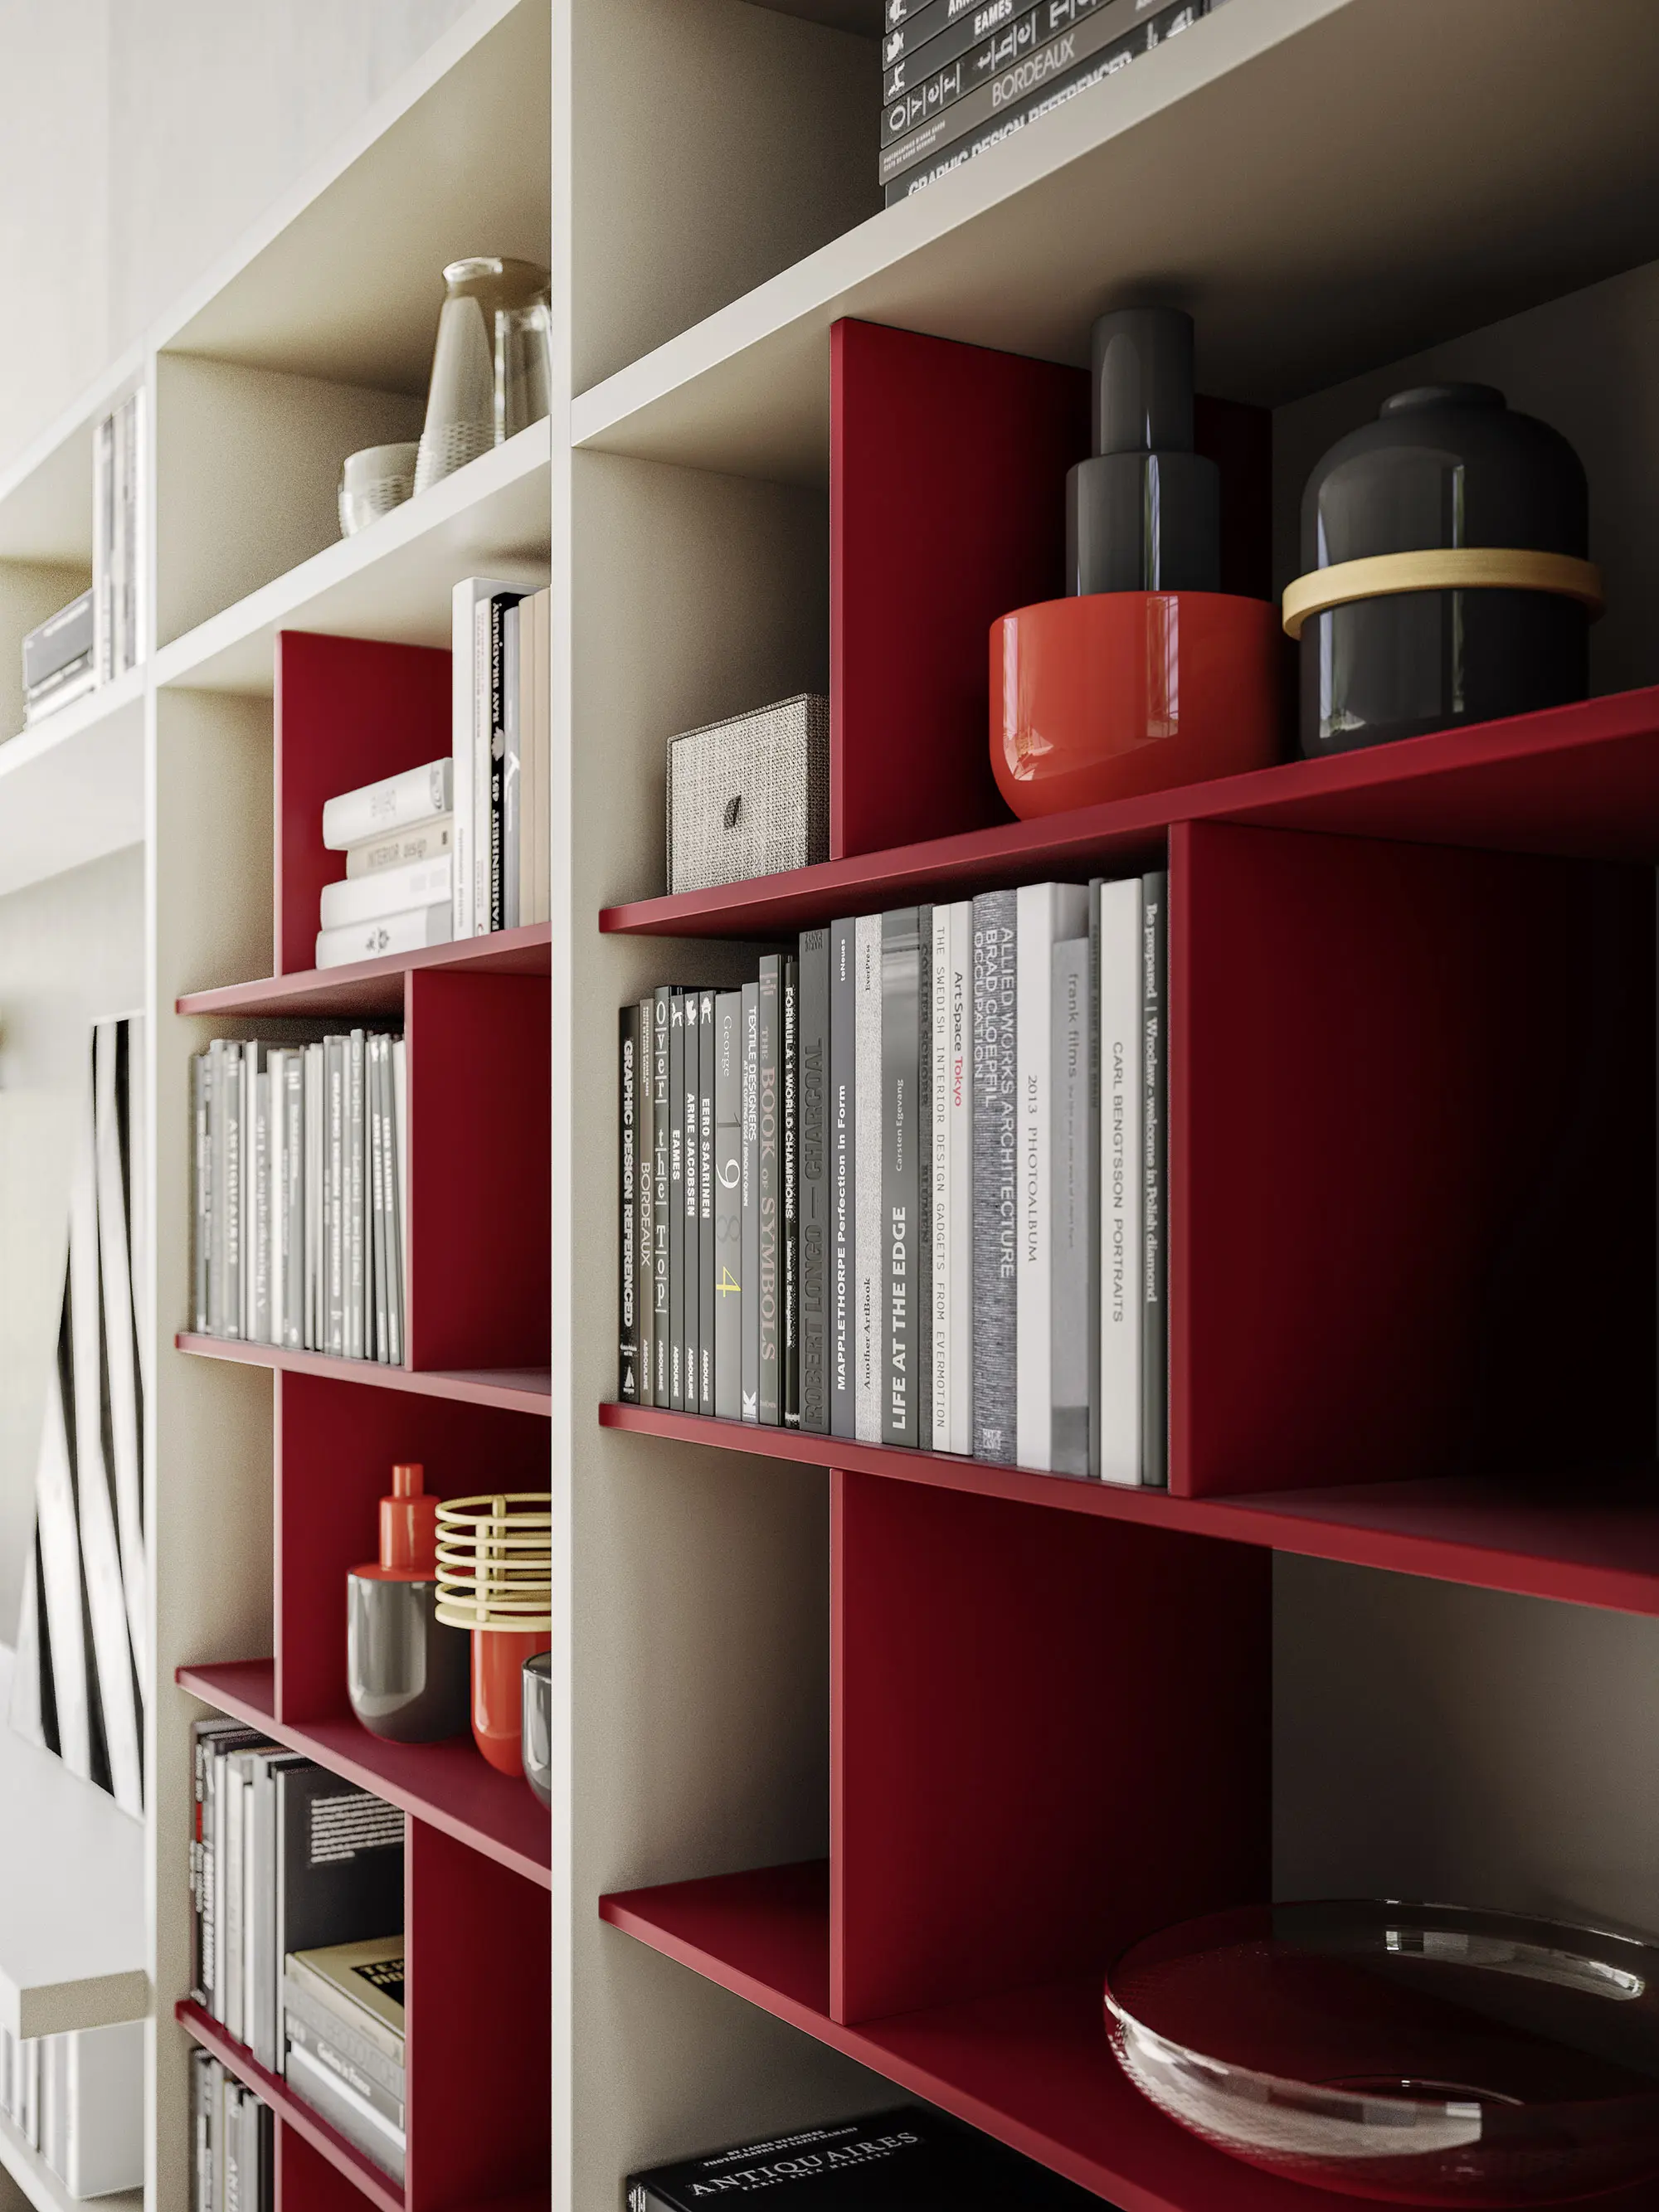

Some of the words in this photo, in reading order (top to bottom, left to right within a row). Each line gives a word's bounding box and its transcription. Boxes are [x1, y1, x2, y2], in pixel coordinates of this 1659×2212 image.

[974, 0, 1013, 36] EAMES
[992, 34, 1074, 107] BORDEAUX
[491, 773, 499, 802] 451
[937, 926, 945, 955] THE
[1146, 903, 1158, 925] Be
[954, 971, 963, 998] Art
[985, 929, 997, 991] BRAD
[1000, 928, 1014, 1006] ALLIED
[1144, 926, 1158, 999] prepared
[786, 987, 794, 1059] FORMULA
[937, 967, 945, 1033] SWEDISH
[954, 1000, 963, 1052] Space
[975, 931, 984, 1079] OCCUPATION
[1068, 974, 1079, 1023] frank
[722, 1015, 732, 1077] George
[748, 1006, 757, 1061] TEXTILE
[985, 999, 997, 1108] CLOEPFIL
[1000, 1013, 1014, 1094] WORKS
[1068, 1030, 1079, 1078] films
[1113, 1042, 1123, 1090] CARL
[624, 1040, 634, 1125] GRAPHIC
[687, 1093, 695, 1134] ARNE
[748, 1063, 757, 1141] DESIGNERS
[761, 1067, 775, 1159] BOOK
[786, 1074, 794, 1128] WORLD
[805, 1038, 823, 1180] CHARCOAL
[838, 1086, 846, 1129] Form
[896, 1079, 904, 1125] Egevang
[937, 1047, 945, 1123] INTERIOR
[954, 1056, 963, 1107] Tokyo
[1028, 1074, 1038, 1115] 2013
[702, 1098, 710, 1136] EERO
[838, 1135, 846, 1150] in
[1146, 1096, 1158, 1167] welcome
[624, 1130, 634, 1199] DESIGN
[672, 1129, 680, 1180] EAMES
[687, 1138, 695, 1217] JACOBSEN
[702, 1140, 710, 1218] SAARINEN
[761, 1168, 769, 1189] OF
[786, 1130, 794, 1218] CHAMPIONS
[937, 1135, 945, 1192] DESIGN
[1113, 1095, 1123, 1208] BENGTSSON
[1146, 1169, 1158, 1184] in
[641, 1162, 651, 1266] BORDEAUX
[838, 1155, 846, 1242] Perfection
[1000, 1101, 1014, 1278] ARCHITECTURE
[1028, 1127, 1038, 1262] PHOTOALBUM
[1146, 1186, 1158, 1232] Polish
[624, 1204, 634, 1327] REFERENCED
[805, 1224, 823, 1313] LONGO
[893, 1207, 906, 1276] EDGE
[937, 1203, 945, 1271] GADGETS
[1113, 1218, 1123, 1323] PORTRAITS
[1146, 1233, 1158, 1302] diamond
[761, 1197, 775, 1360] SYMBOLS
[893, 1282, 906, 1332] THE
[937, 1283, 945, 1320] FROM
[838, 1247, 846, 1390] MAPPLETHORPE
[805, 1318, 823, 1426] ROBERT
[893, 1338, 906, 1372] AT
[937, 1332, 945, 1428] EVERMOTION
[893, 1378, 906, 1429] LIFE
[692, 2132, 919, 2196] ANTIQUAIRES
